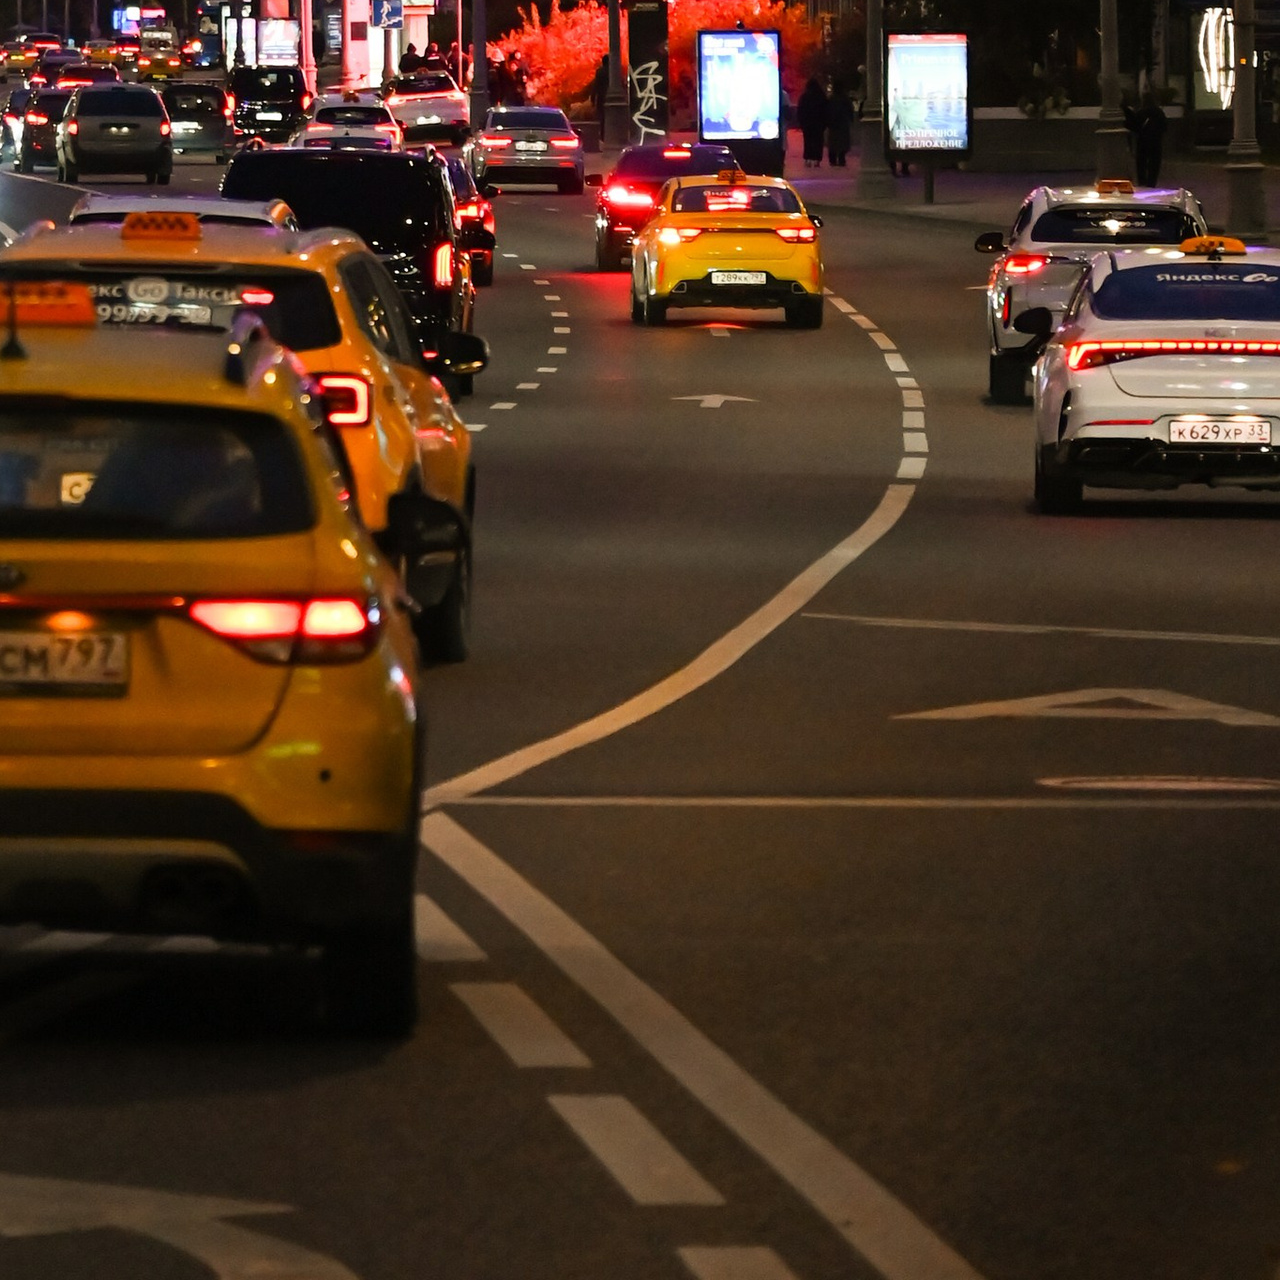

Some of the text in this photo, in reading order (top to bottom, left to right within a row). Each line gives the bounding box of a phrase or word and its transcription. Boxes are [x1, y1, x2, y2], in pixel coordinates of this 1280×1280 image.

[895, 139, 964, 148] ПРЕДЛОЖЕНИЕ
[1156, 273, 1240, 282] Яндекс
[175, 282, 237, 302] Такси
[1178, 424, 1264, 440] К629ХР 33
